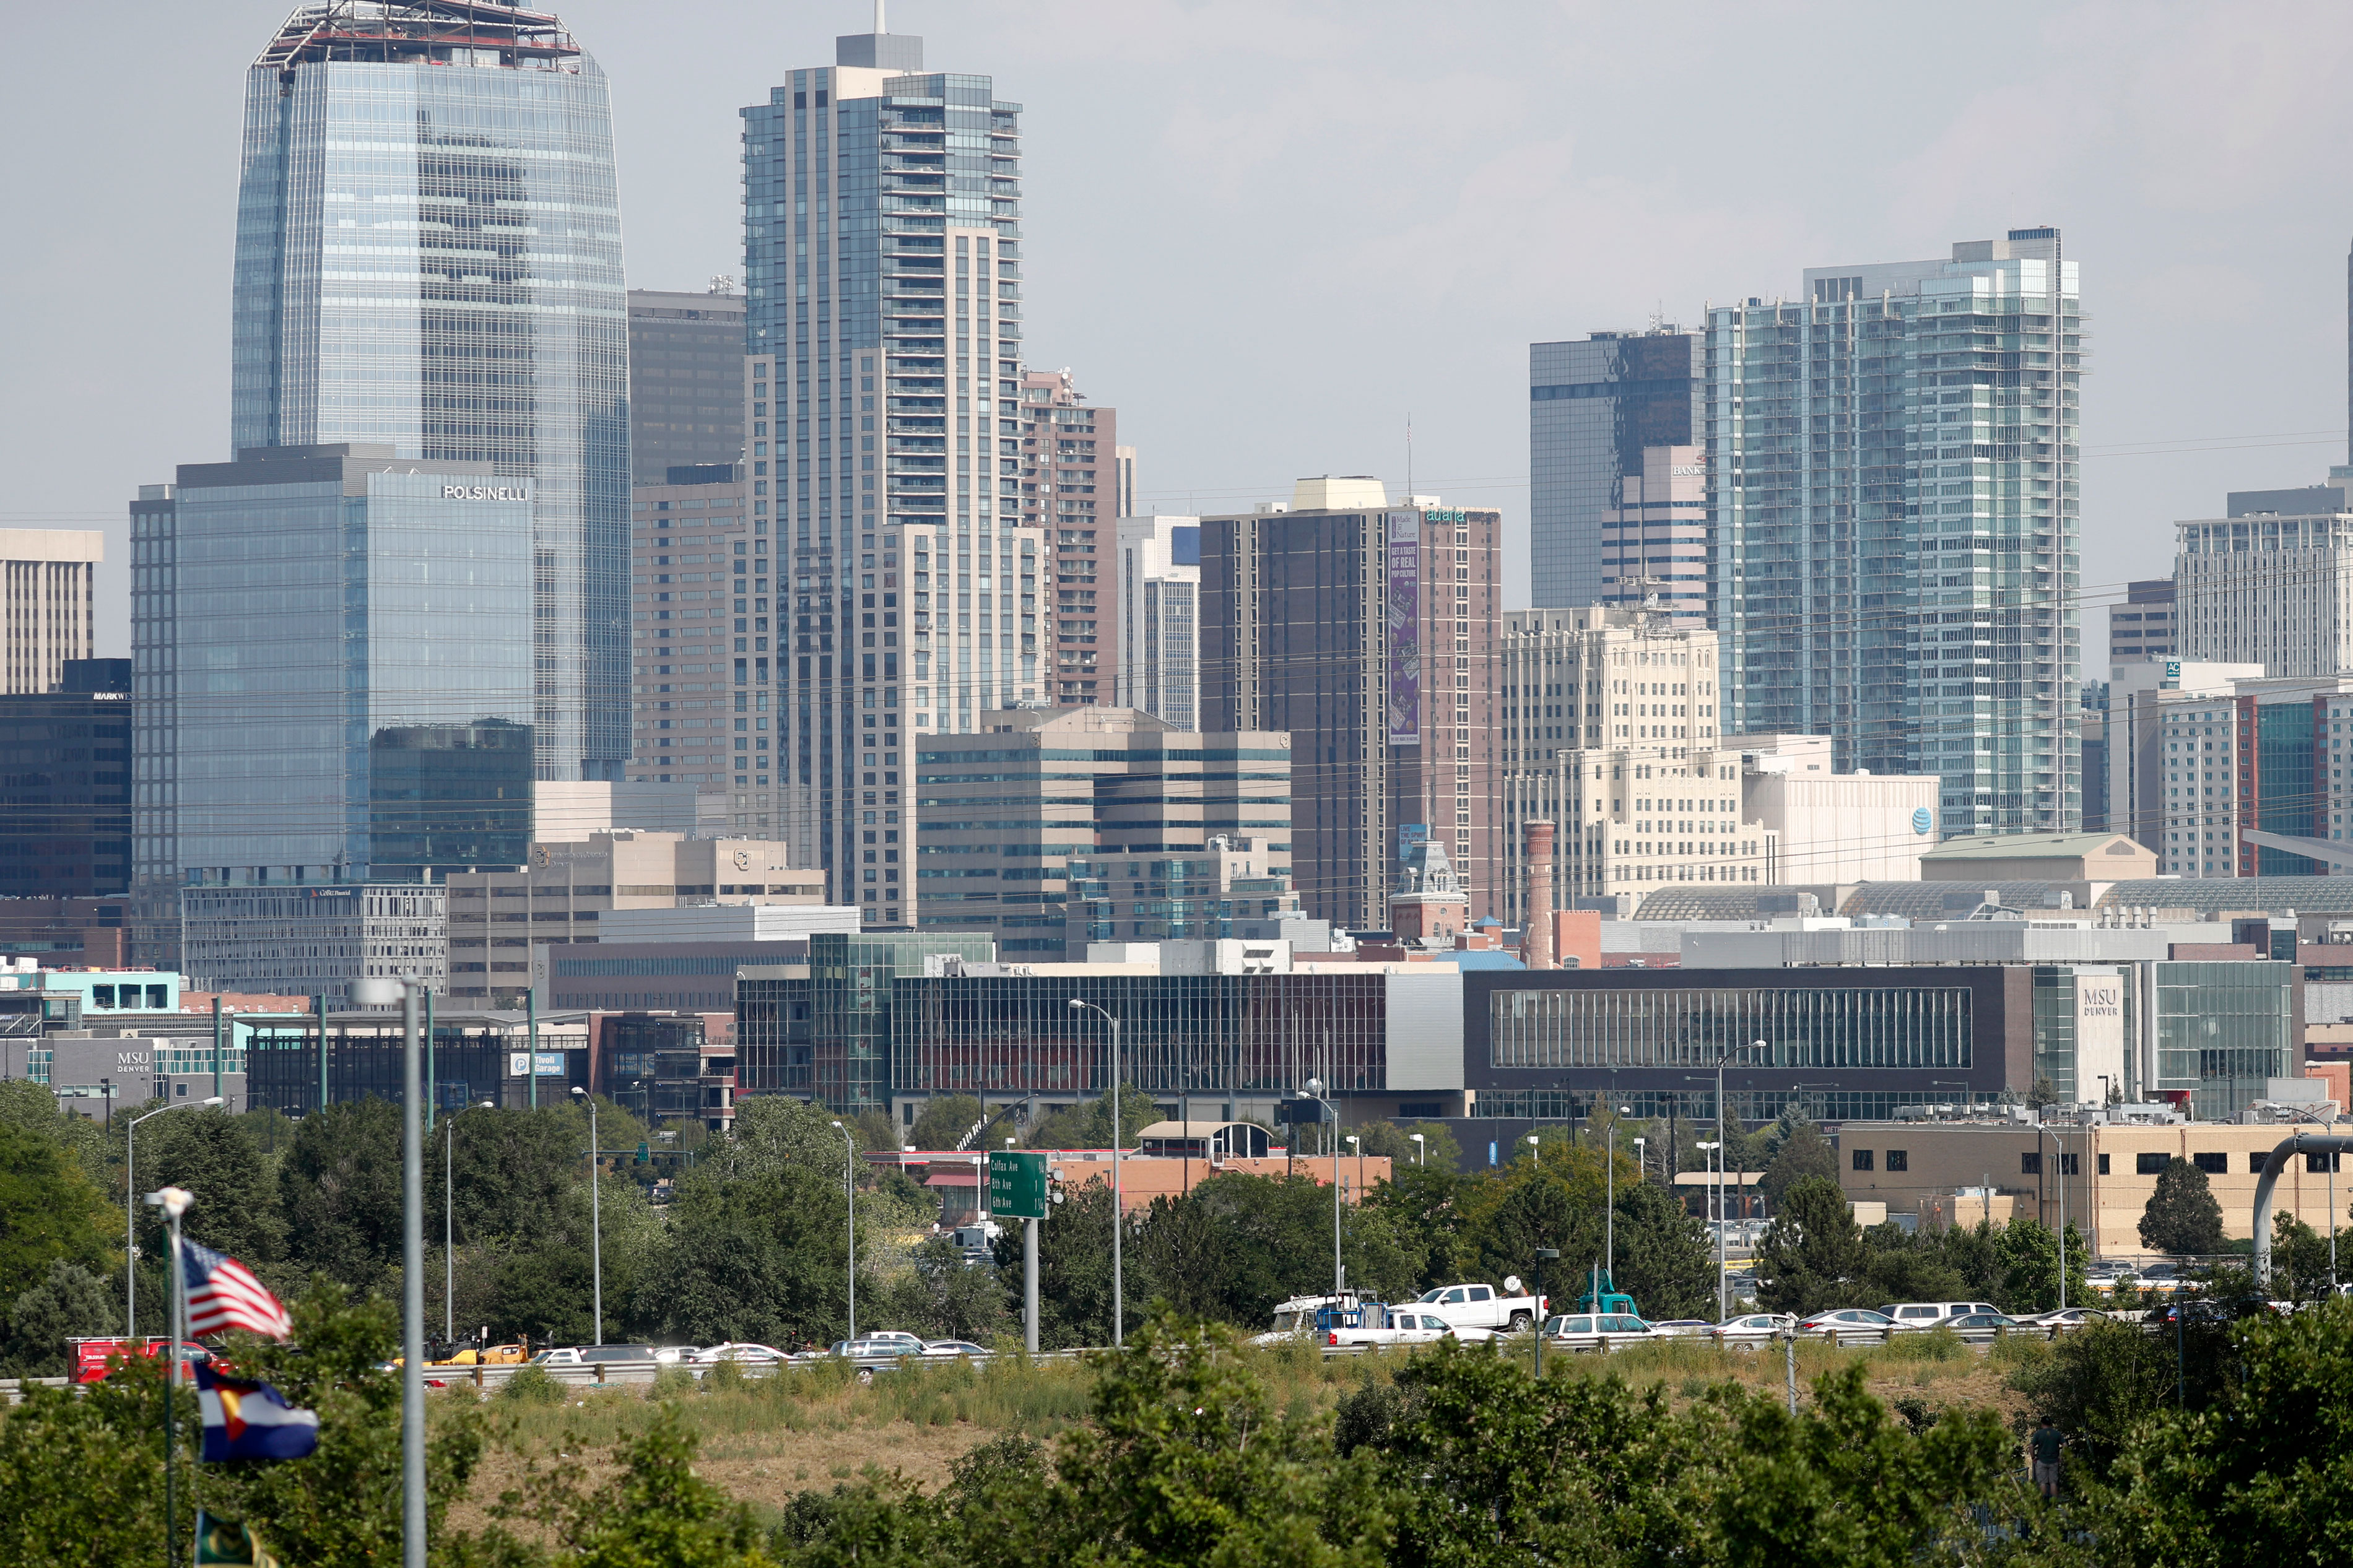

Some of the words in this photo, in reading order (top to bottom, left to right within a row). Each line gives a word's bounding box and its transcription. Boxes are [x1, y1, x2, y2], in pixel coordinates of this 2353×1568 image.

[1673, 466, 1701, 475] BANK
[445, 485, 528, 501] POLSINELLI
[1391, 547, 1399, 555] GET
[1400, 547, 1404, 555] A
[1404, 546, 1416, 555] TASTE
[1391, 557, 1400, 568] OF
[1401, 557, 1416, 568] REAL
[1391, 570, 1399, 578] POP
[1400, 570, 1416, 578] CULTURE
[2168, 663, 2180, 672] AC
[2084, 989, 2116, 1005] MSU
[2084, 1007, 2118, 1016] DENVER
[118, 1052, 149, 1064] MSU
[534, 1055, 555, 1064] Tivoli
[534, 1064, 560, 1073] Garage
[991, 1159, 1007, 1172] Colfax
[1009, 1160, 1018, 1172] Ave
[991, 1177, 1001, 1189] 8th
[1002, 1178, 1012, 1190] Ave
[993, 1196, 1001, 1208] 6th
[1002, 1197, 1012, 1208] Ave
